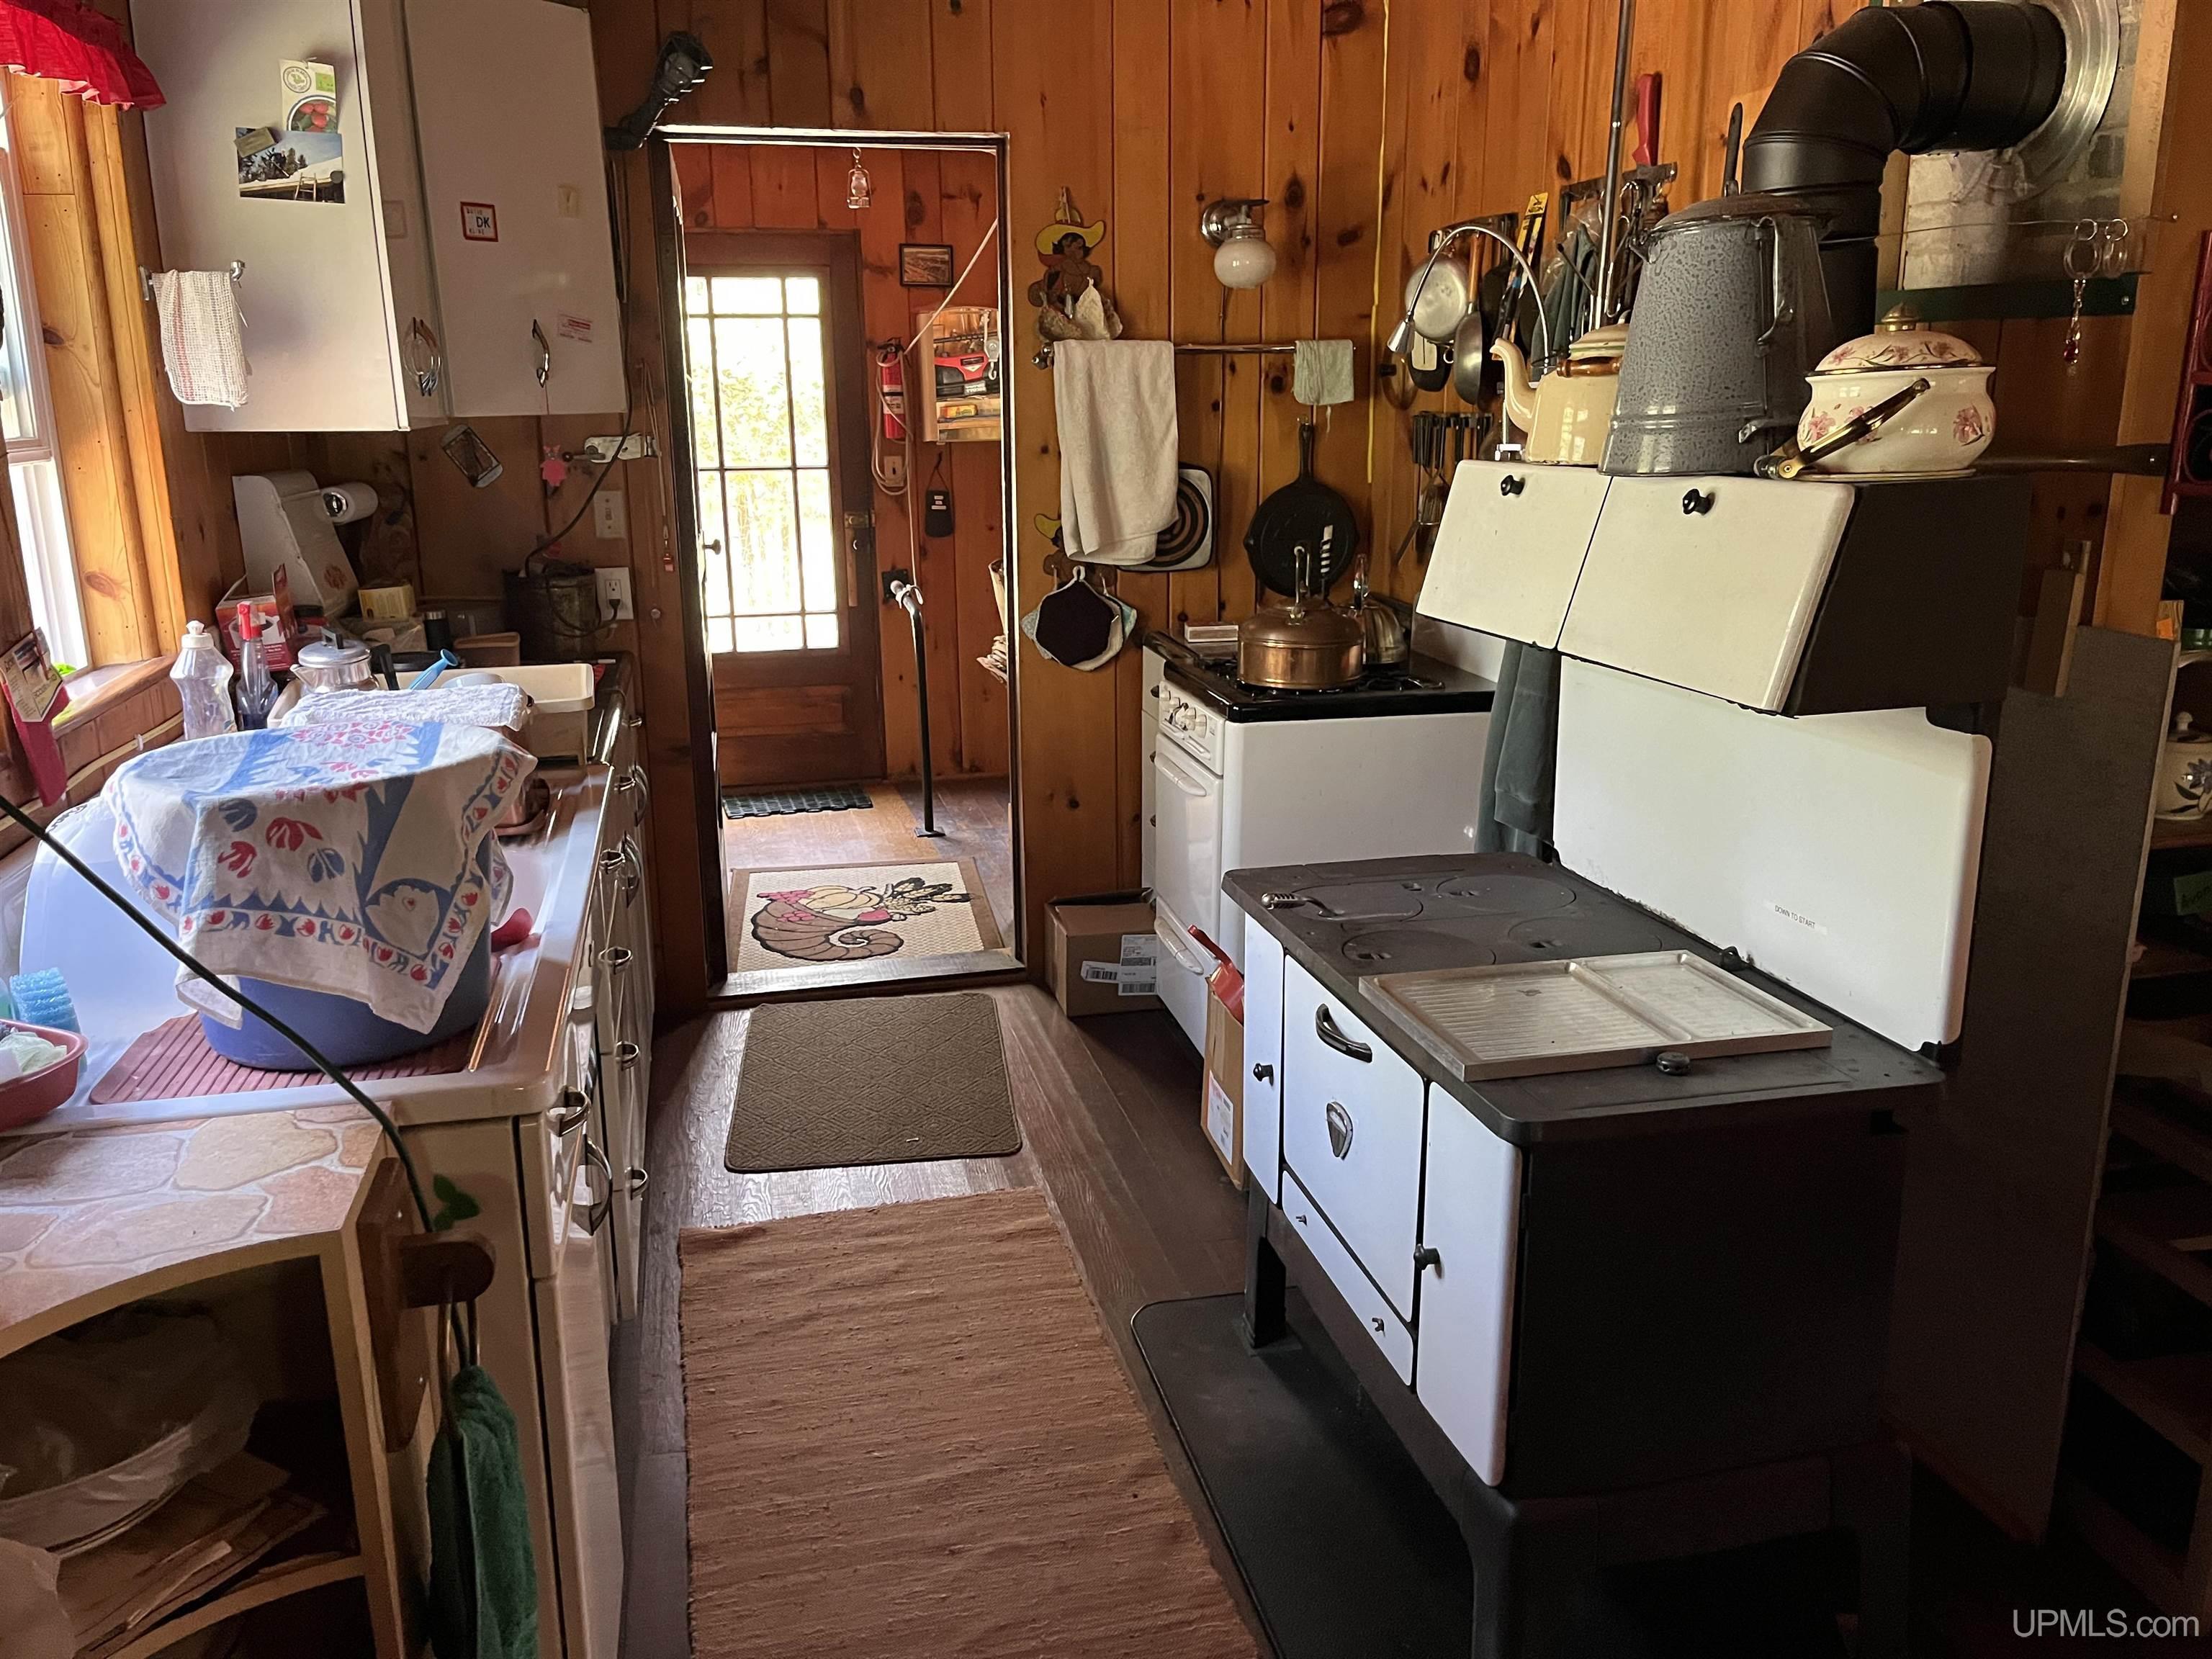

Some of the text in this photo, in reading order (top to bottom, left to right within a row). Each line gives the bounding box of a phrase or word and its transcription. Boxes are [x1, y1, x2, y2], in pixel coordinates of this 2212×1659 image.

[476, 216, 490, 228] DK
[1775, 904, 1815, 929] DOWN TO START
